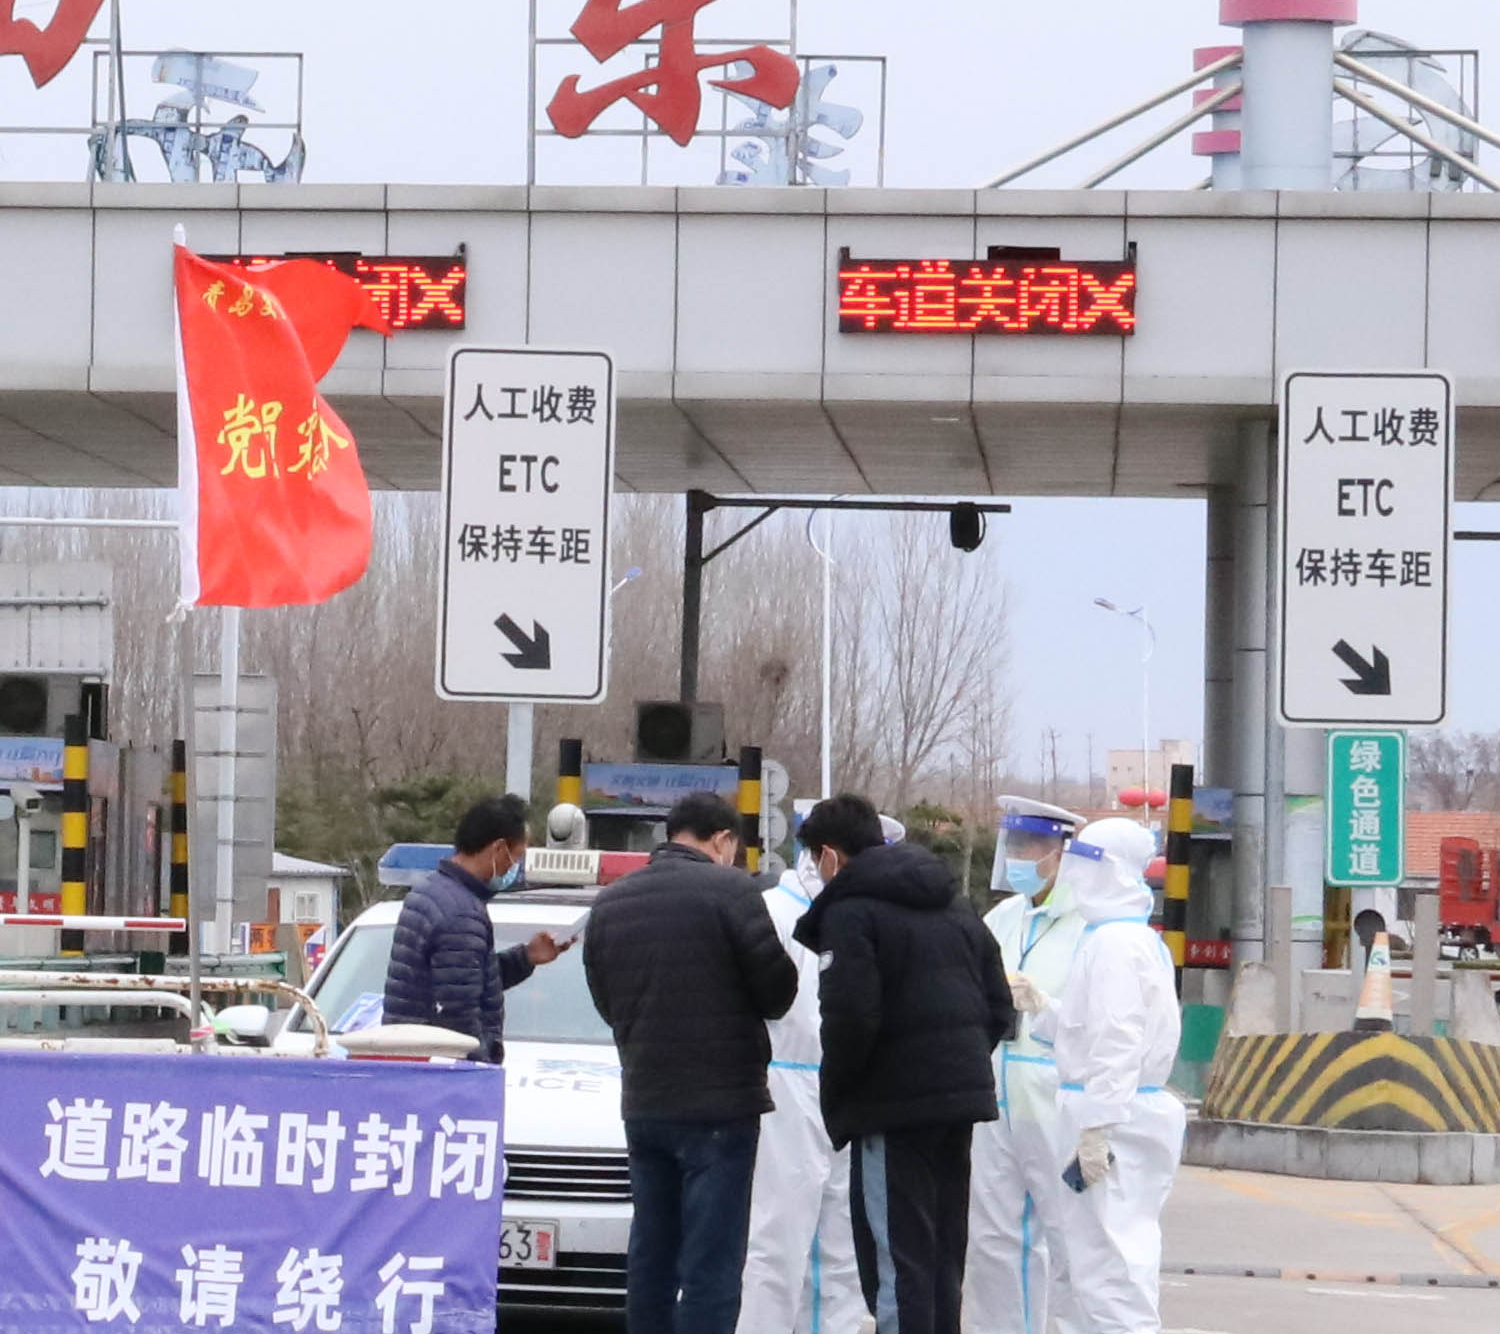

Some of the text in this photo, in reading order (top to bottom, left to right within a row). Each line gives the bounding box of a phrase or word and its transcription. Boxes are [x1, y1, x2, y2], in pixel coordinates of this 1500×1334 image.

[463, 383, 597, 424] 人工收费
[1303, 406, 1440, 447] 人工收费
[498, 454, 561, 493] ETC
[1336, 478, 1395, 517] ETC
[457, 523, 592, 564] 保持车距
[1295, 548, 1433, 588] 保持车距
[1348, 740, 1382, 876] 绿色通道
[40, 1097, 499, 1202] 道路临时封闭
